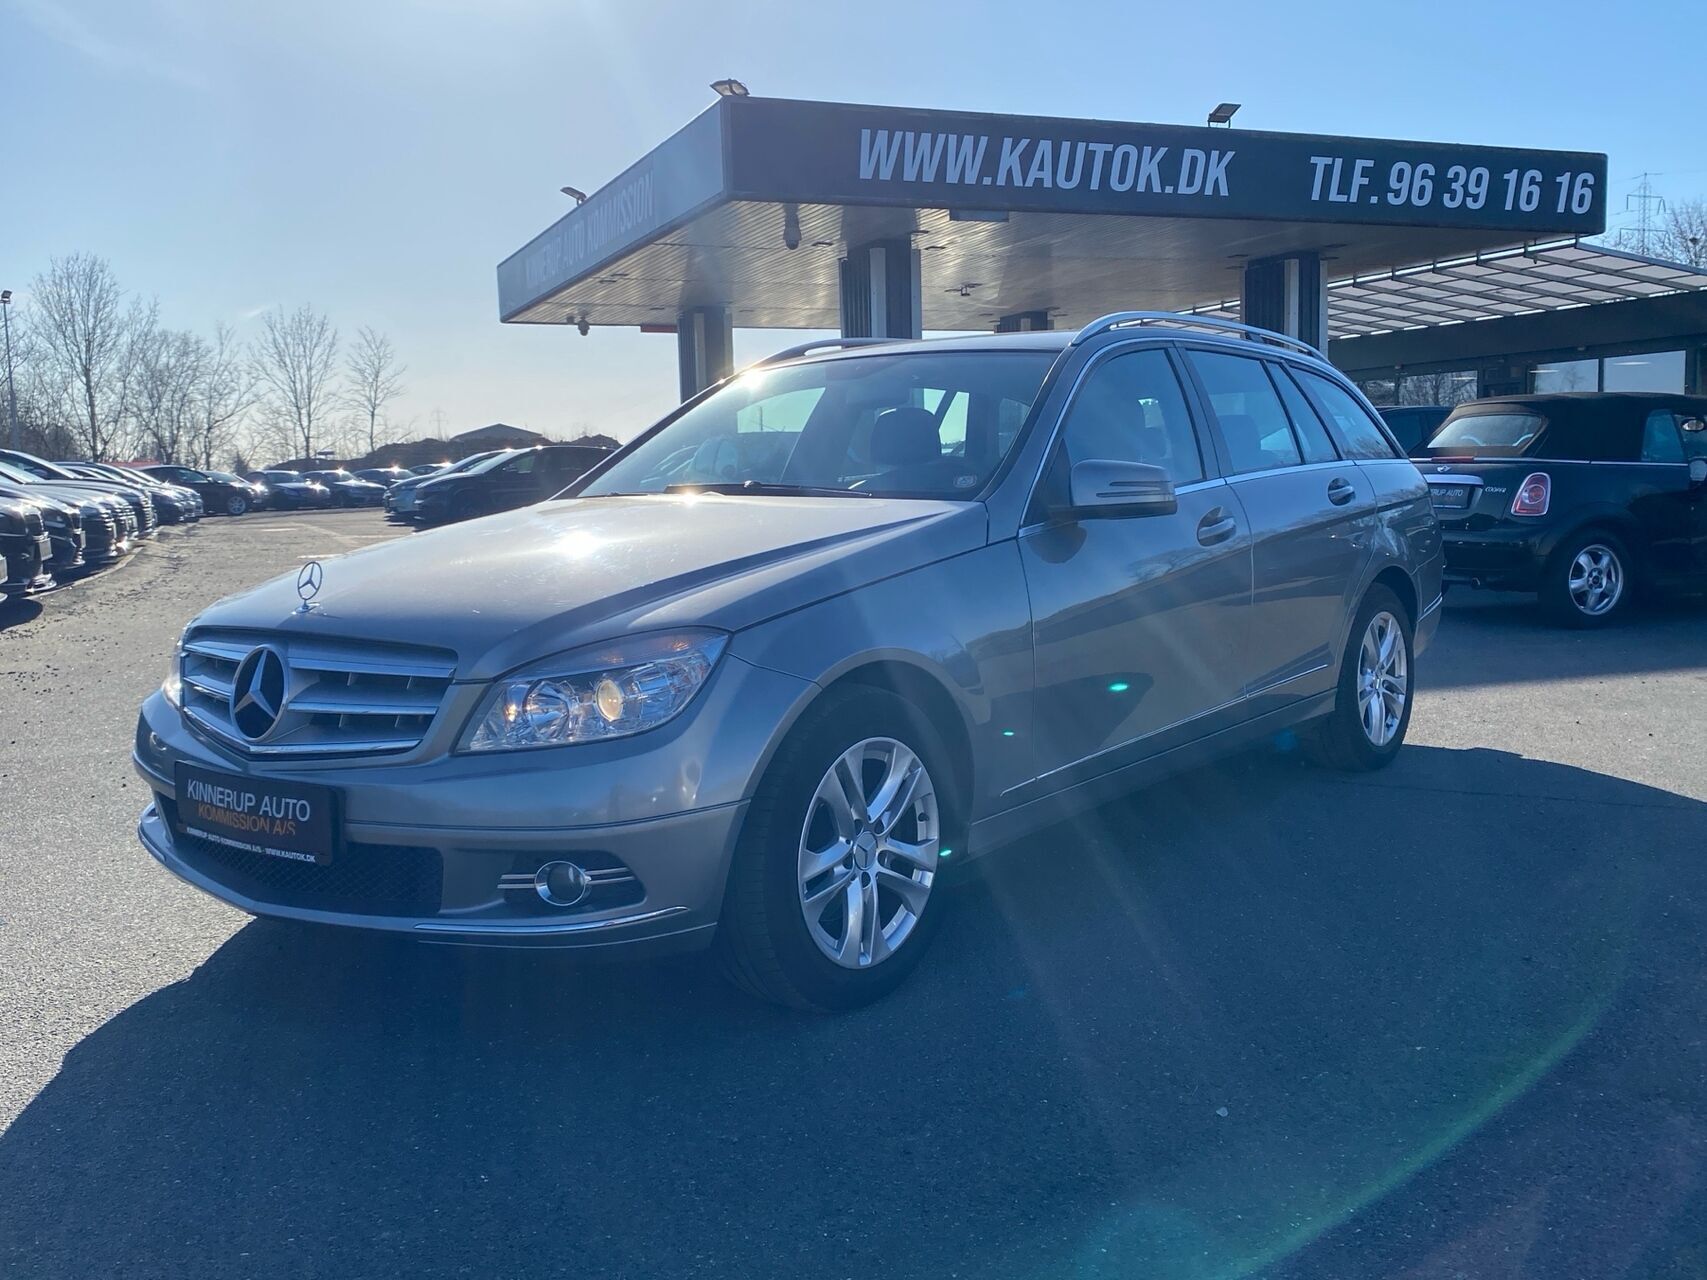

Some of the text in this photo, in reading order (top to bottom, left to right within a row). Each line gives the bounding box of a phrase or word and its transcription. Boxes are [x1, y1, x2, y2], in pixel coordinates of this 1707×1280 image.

[859, 128, 1236, 197] WWW.KAUTOK.DK
[1309, 156, 1594, 214] TLF. 96 39 16 16
[187, 779, 310, 822] KINNERUP AUTO
[198, 803, 295, 836] KOMMISSION A/S
